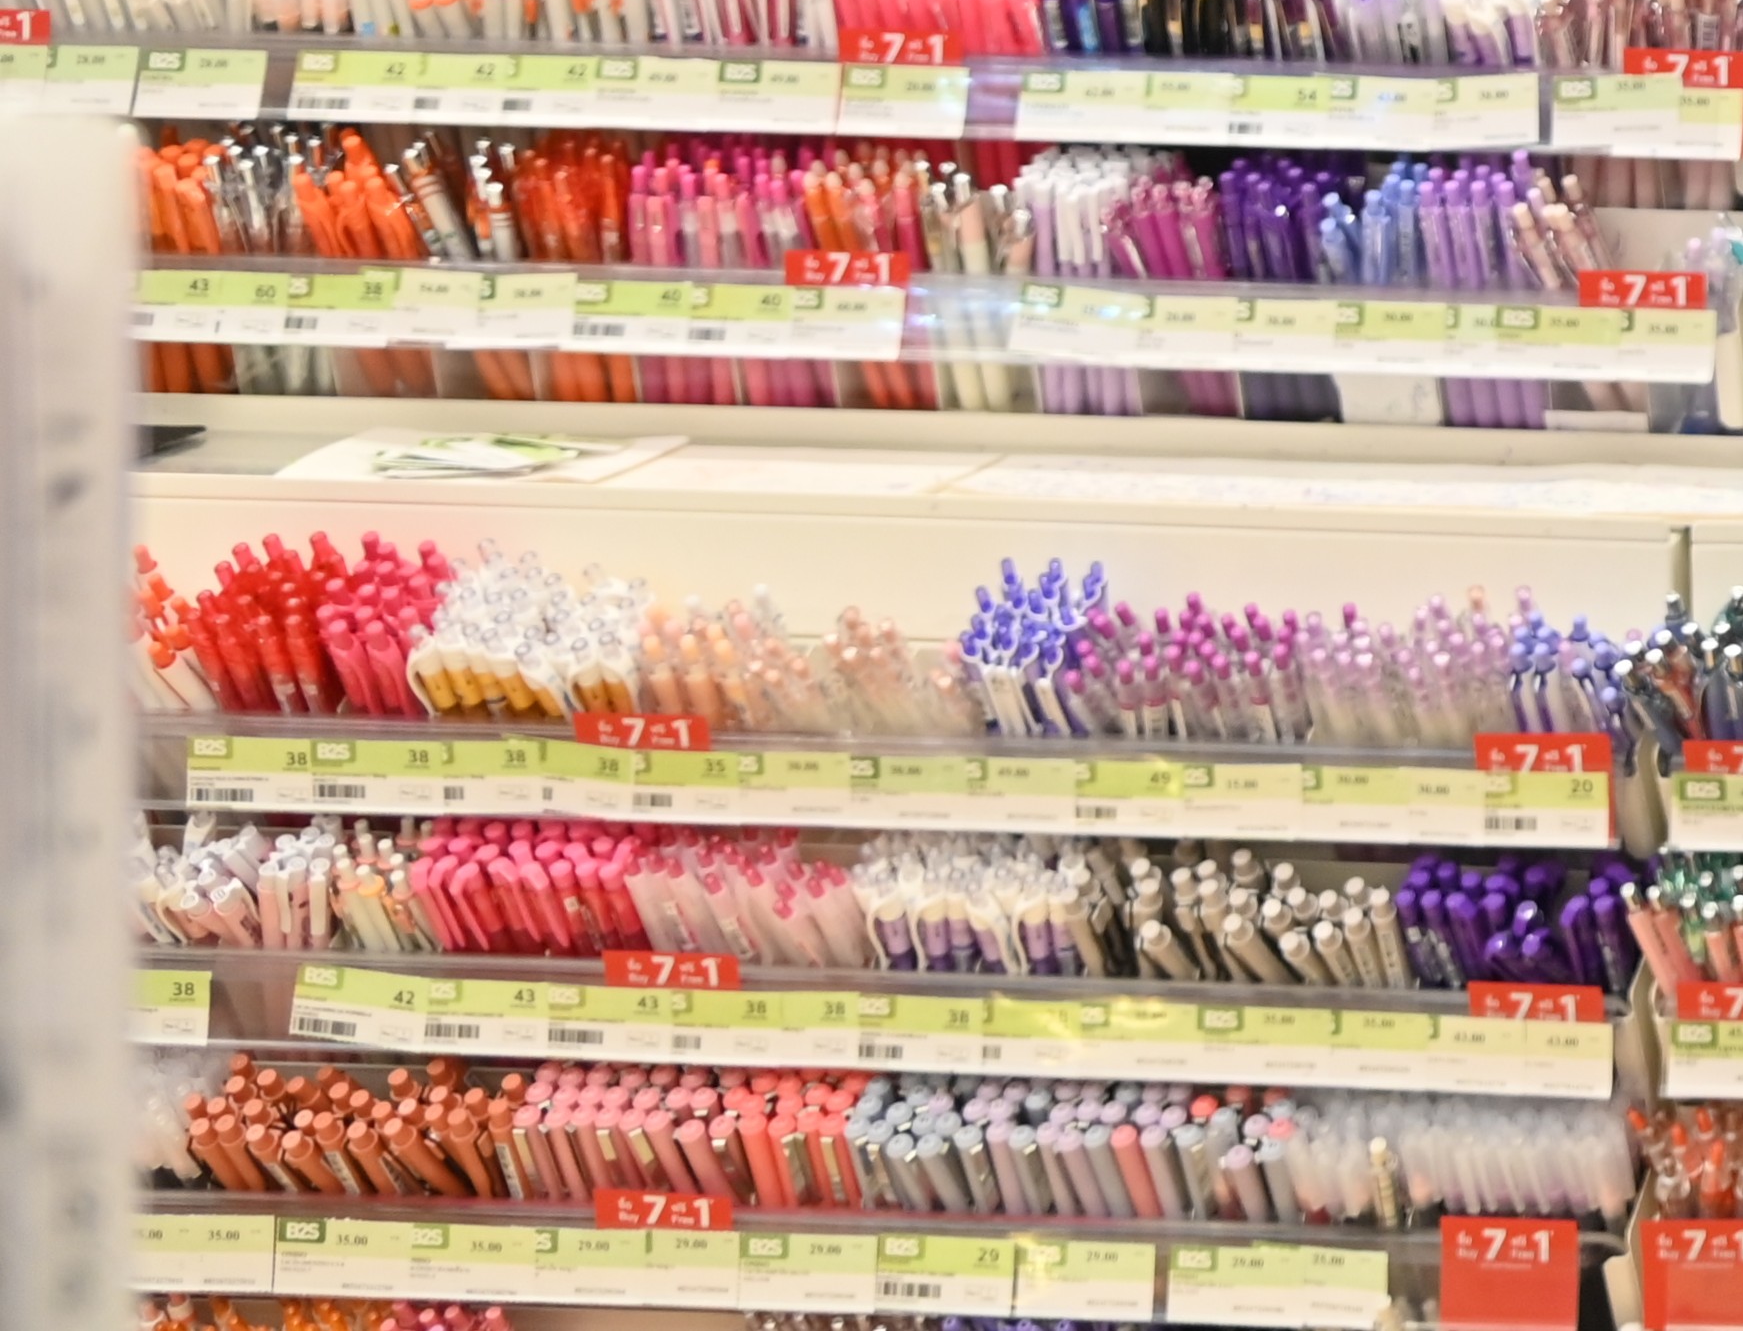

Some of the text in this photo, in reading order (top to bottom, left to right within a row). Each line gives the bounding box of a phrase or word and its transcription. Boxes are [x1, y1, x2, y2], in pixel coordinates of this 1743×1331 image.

[827, 251, 894, 287] 7 1
[1624, 274, 1687, 308] 7 1
[193, 738, 227, 756] B2S
[286, 751, 308, 767] 38
[303, 966, 338, 987] B2S
[651, 955, 675, 986] 7
[700, 957, 719, 987] 1
[172, 981, 195, 997] 38
[513, 988, 536, 1003] 43
[393, 990, 415, 1006] 42
[208, 1229, 241, 1242] 35.00
[285, 1221, 320, 1240] B2S
[337, 1233, 369, 1246] 35.00
[578, 1239, 610, 1252] 29.00
[973, 1247, 1000, 1267] 29
